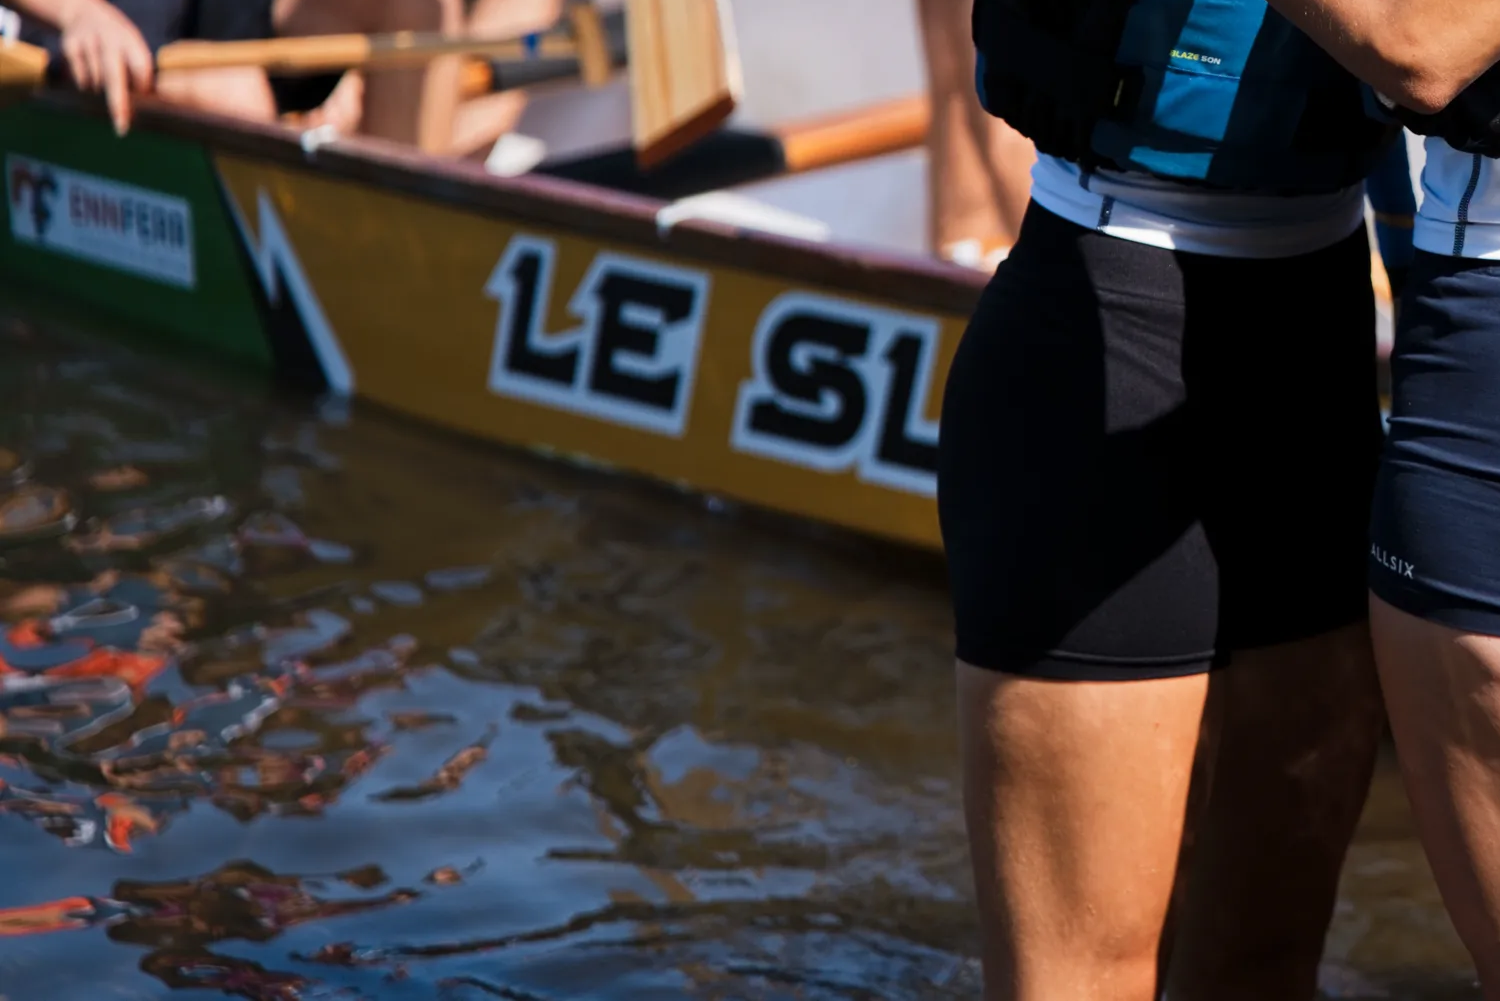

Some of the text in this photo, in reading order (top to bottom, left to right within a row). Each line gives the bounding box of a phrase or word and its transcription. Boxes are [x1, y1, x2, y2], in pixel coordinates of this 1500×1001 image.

[1170, 49, 1199, 61] BLAZE
[487, 236, 709, 434] LE
[1371, 542, 1415, 580] ALLSIX
